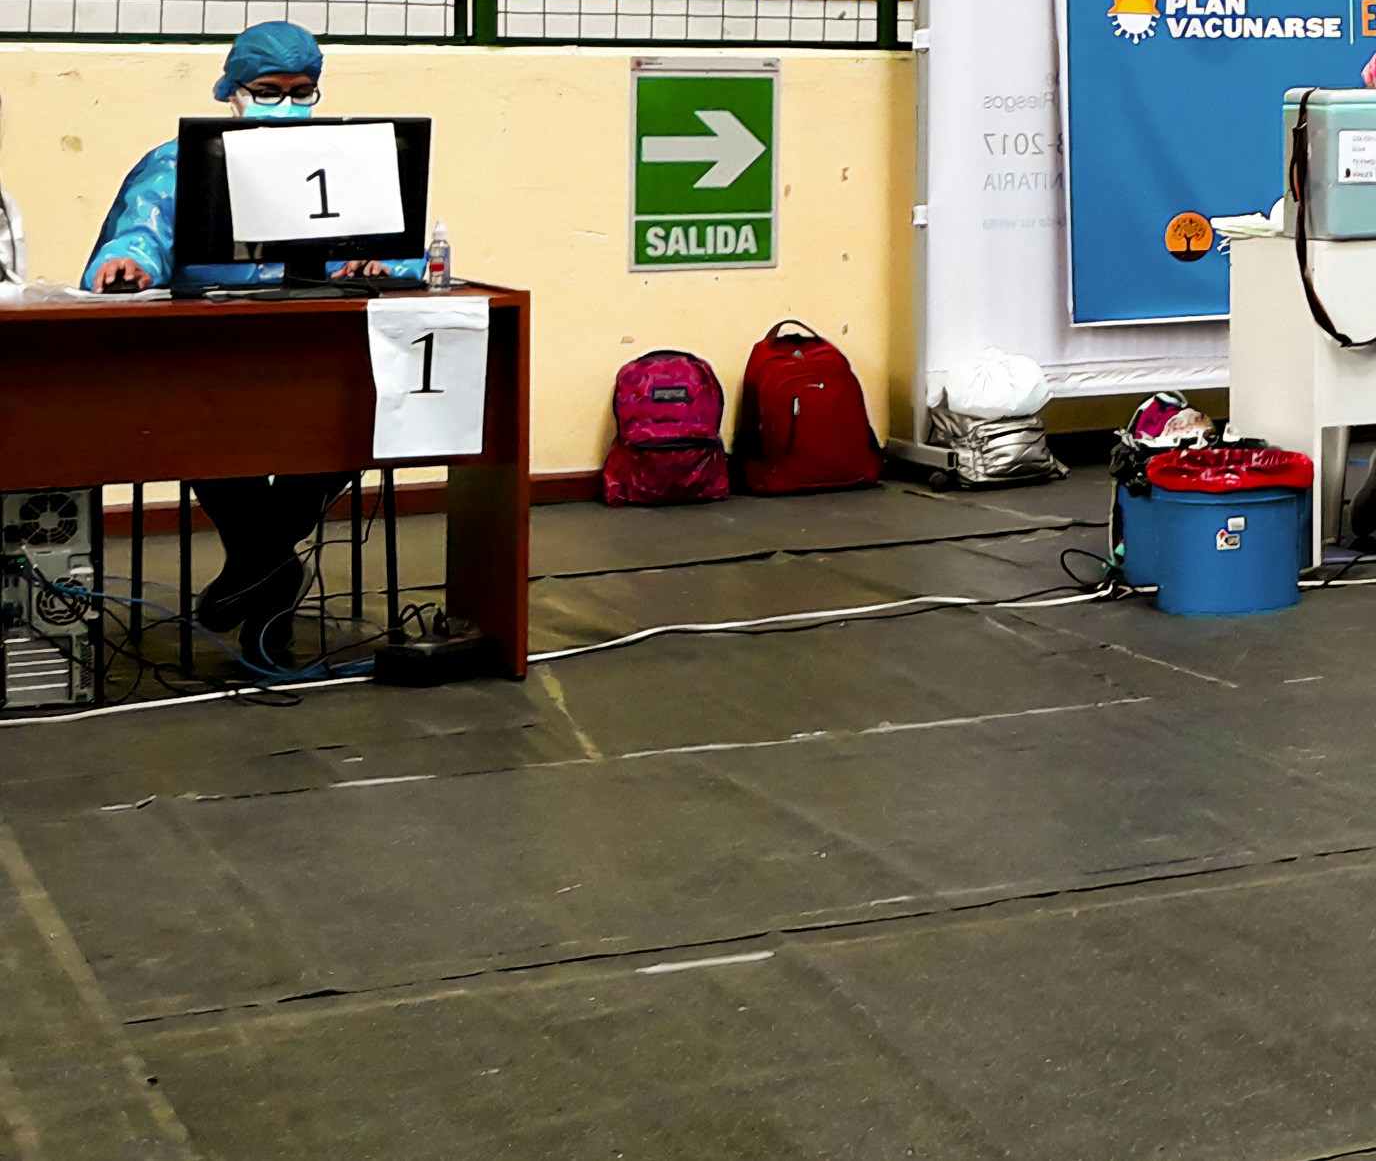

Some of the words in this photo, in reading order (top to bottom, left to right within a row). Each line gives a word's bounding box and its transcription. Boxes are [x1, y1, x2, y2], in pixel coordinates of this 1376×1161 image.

[1165, 17, 1342, 39] VACUNARSE
[306, 168, 341, 219] 1
[645, 225, 758, 257] SALIDA
[409, 332, 445, 394] 1
